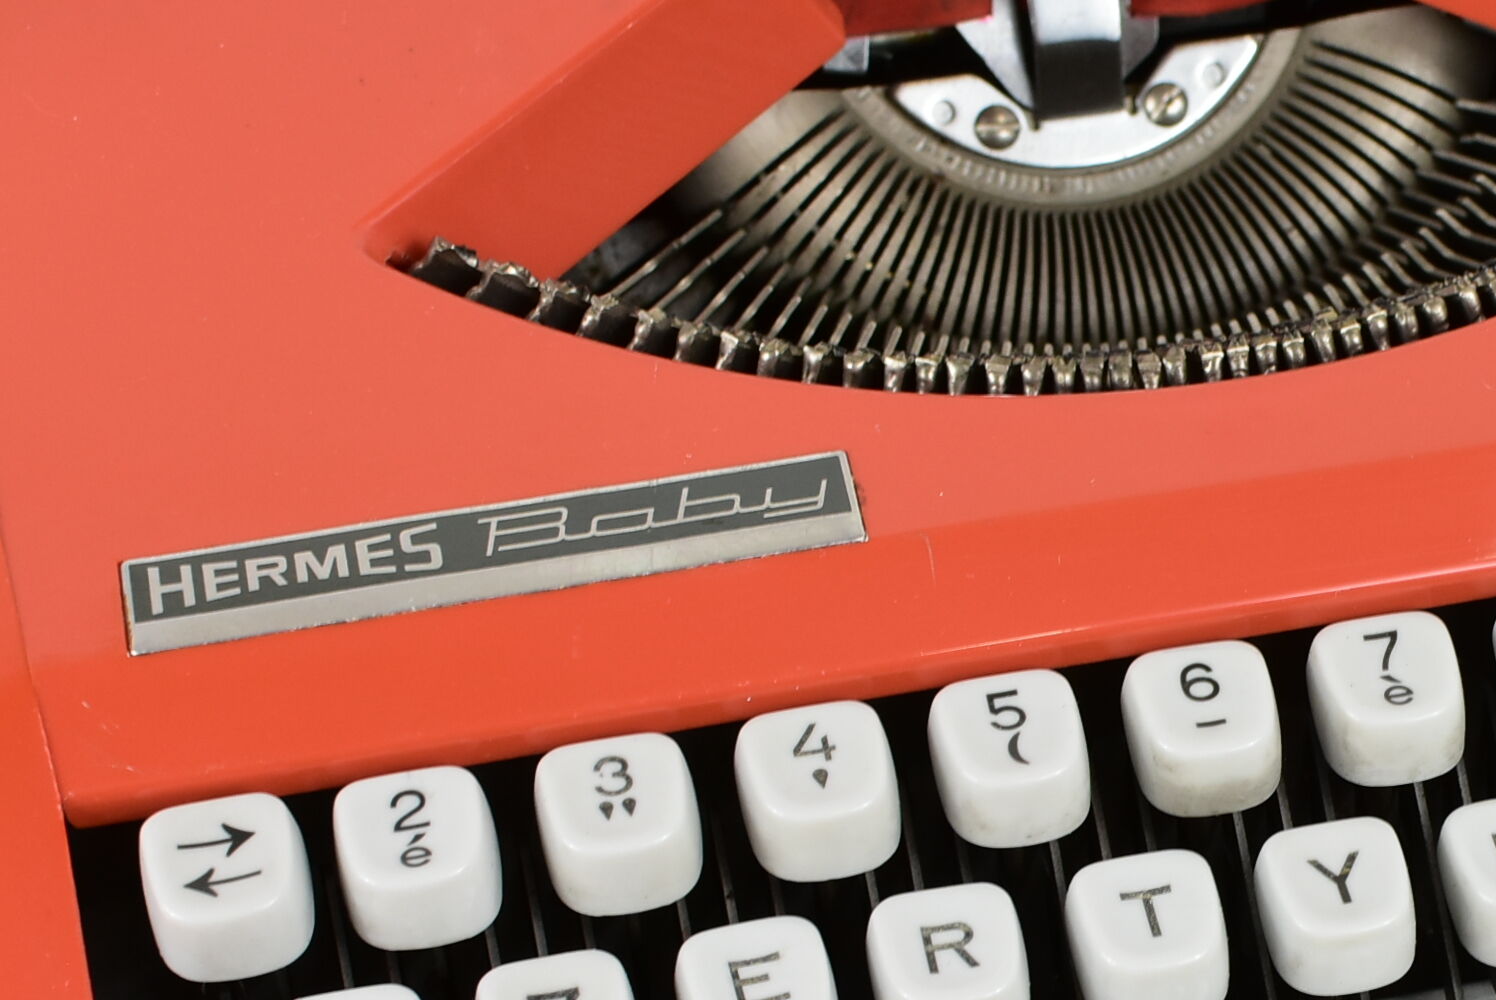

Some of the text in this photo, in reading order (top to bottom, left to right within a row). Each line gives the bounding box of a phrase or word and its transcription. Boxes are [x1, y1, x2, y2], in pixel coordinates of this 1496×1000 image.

[148, 477, 830, 616] HERMES Baby
[1362, 629, 1398, 672] 7
[1179, 662, 1221, 703] 6
[1380, 674, 1414, 706] è
[985, 688, 1027, 732] 5
[792, 722, 837, 762] 4
[593, 755, 634, 797] 3
[389, 789, 431, 833] 2
[399, 832, 433, 869] é
[1307, 850, 1359, 905] Y
[1119, 884, 1172, 938] T
[919, 921, 980, 975] R
